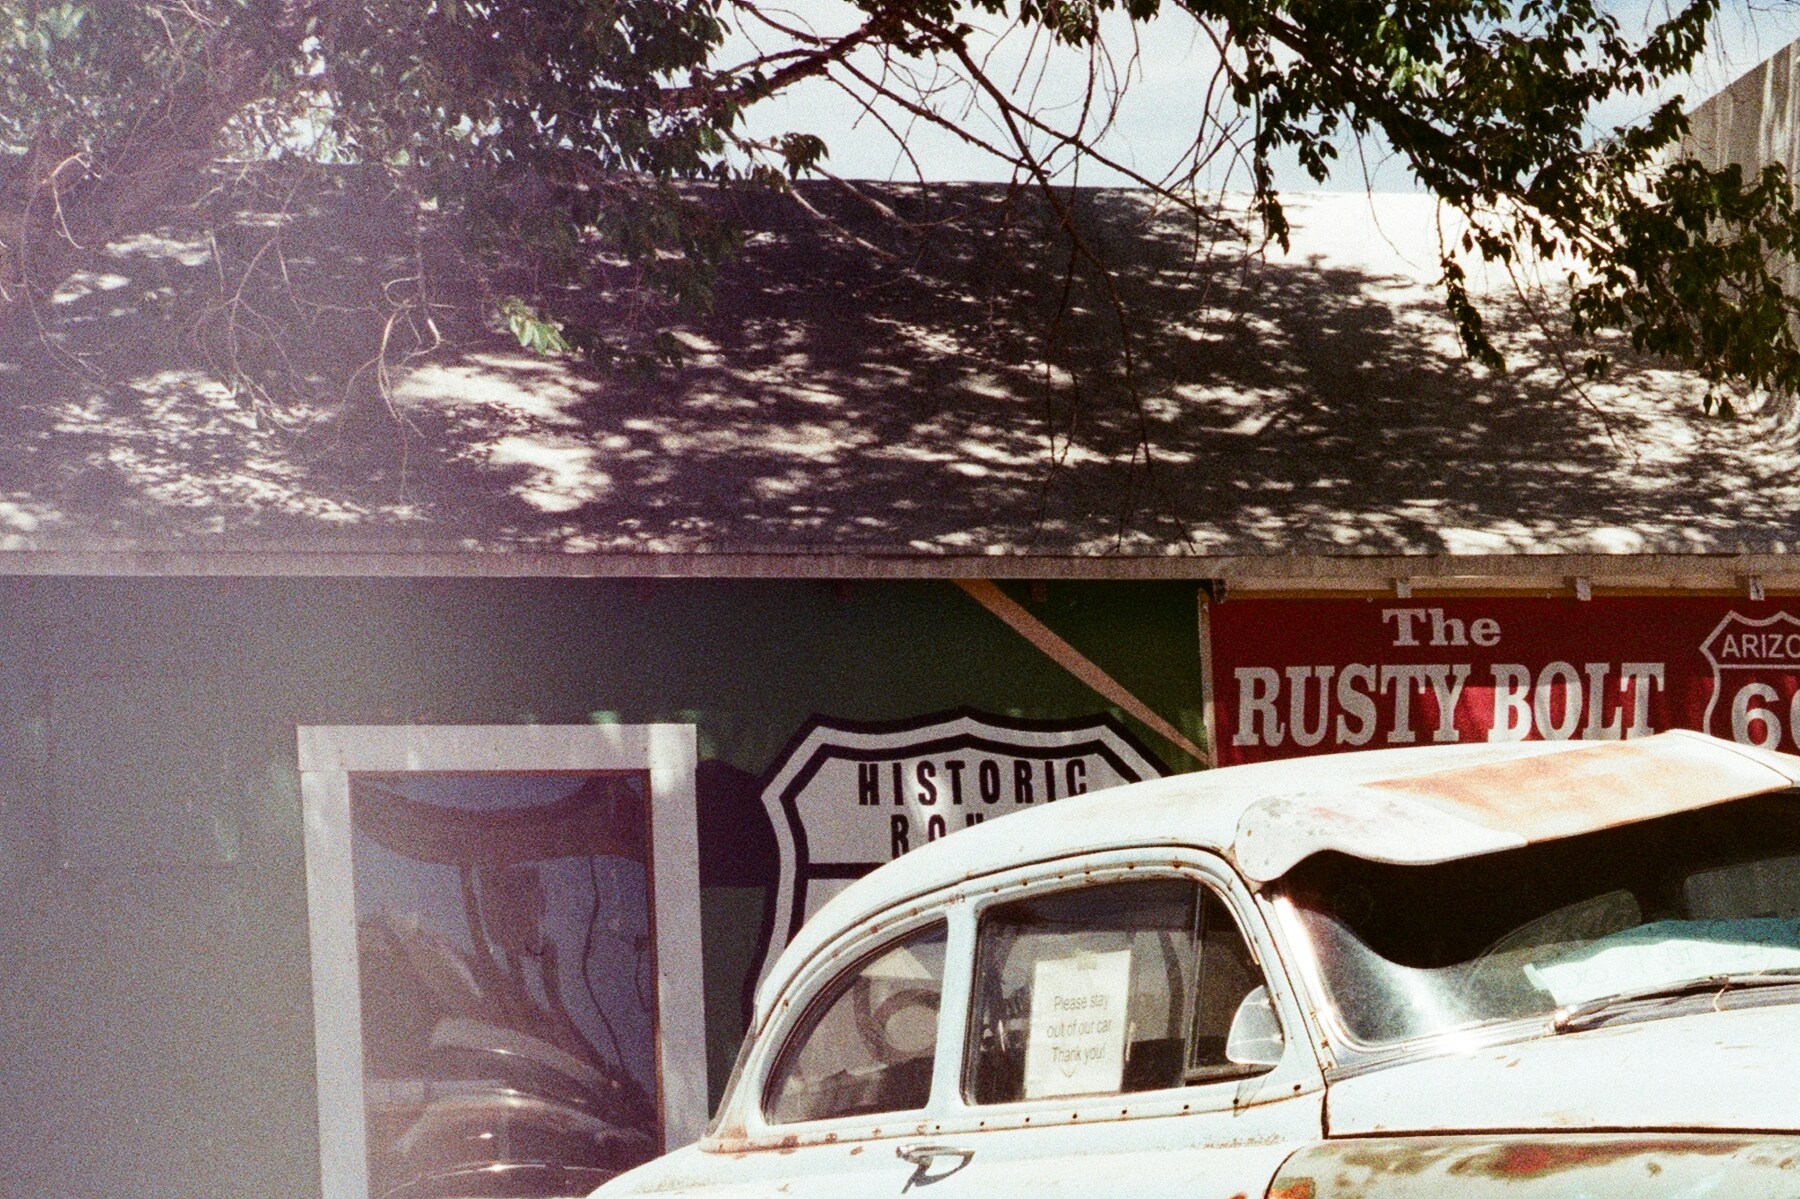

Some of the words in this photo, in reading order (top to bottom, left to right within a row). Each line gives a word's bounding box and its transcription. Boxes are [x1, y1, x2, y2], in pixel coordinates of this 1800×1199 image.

[1382, 608, 1501, 647] The
[1233, 663, 1472, 747] RUSTY
[1488, 661, 1665, 743] BOLT
[858, 759, 1087, 806] HISTORIC
[1054, 995, 1087, 1011] Please
[1090, 993, 1109, 1010] stay
[1047, 1022, 1064, 1038] out
[1067, 1019, 1077, 1037] of
[1078, 1021, 1095, 1036] our
[1097, 1018, 1112, 1034] car
[1052, 1046, 1081, 1063] Thank
